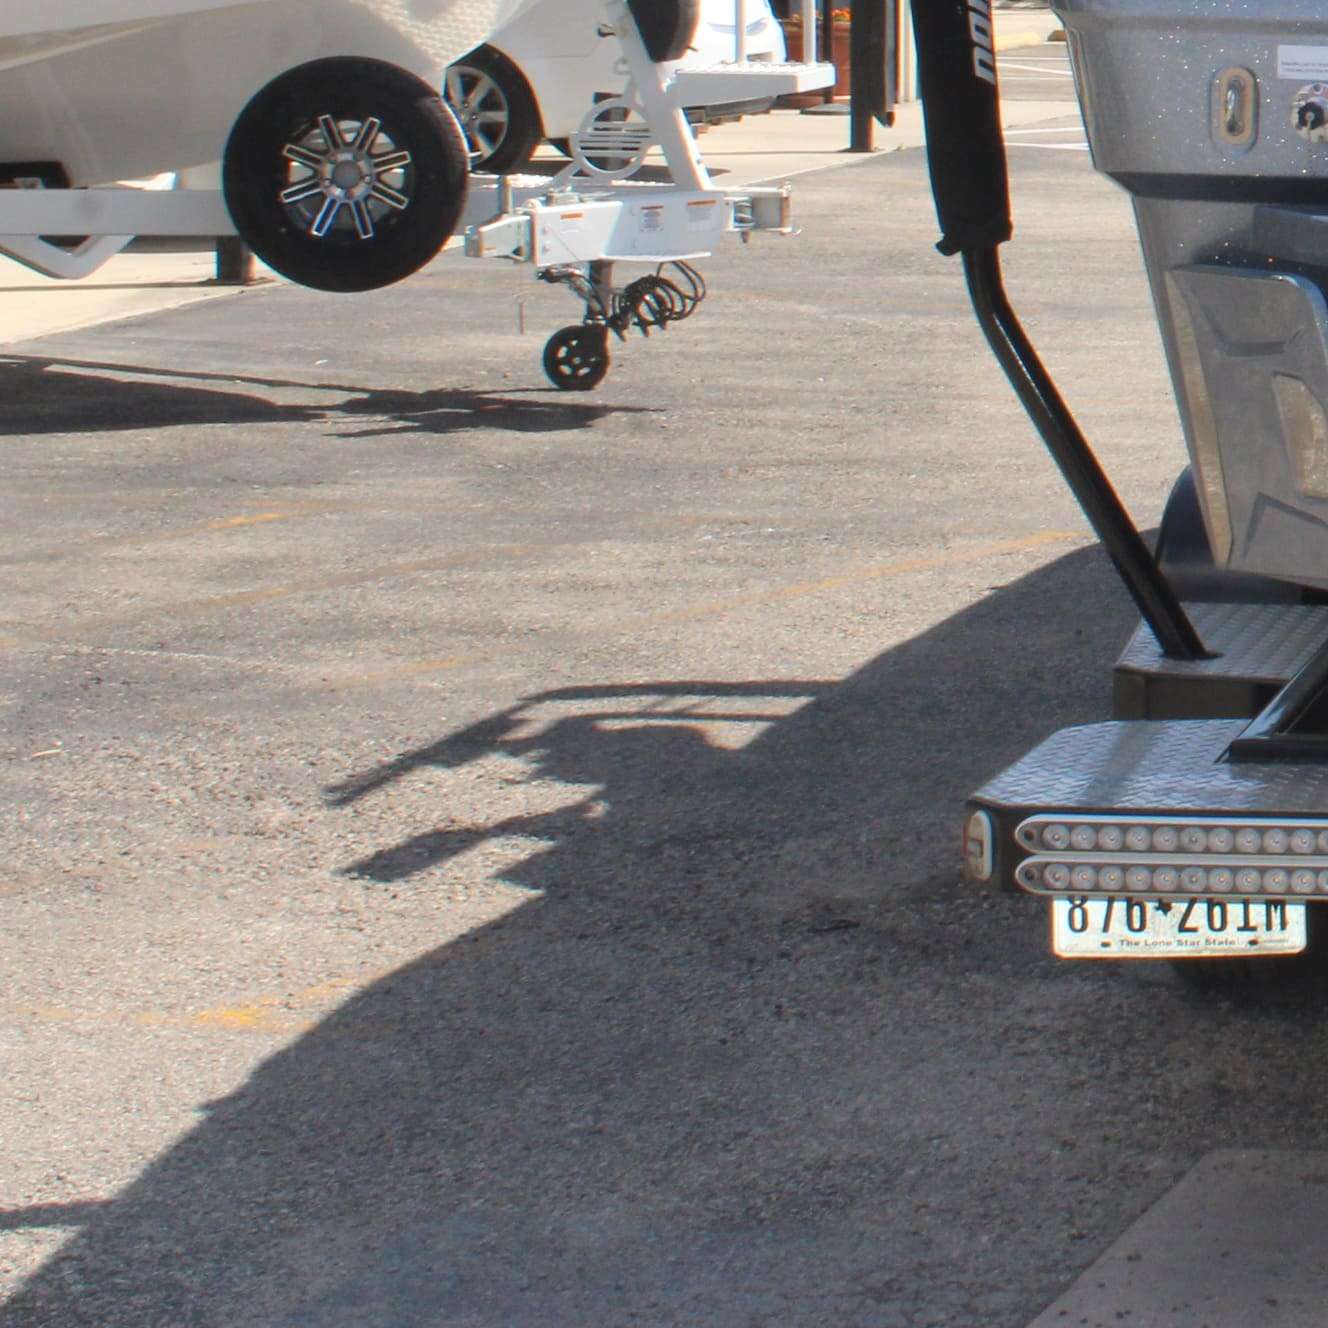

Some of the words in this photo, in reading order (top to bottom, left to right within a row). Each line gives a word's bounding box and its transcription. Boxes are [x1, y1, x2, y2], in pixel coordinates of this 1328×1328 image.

[1120, 938, 1141, 947] The
[1144, 938, 1173, 947] Lone
[1177, 938, 1200, 947] Star
[1205, 938, 1236, 947] State
